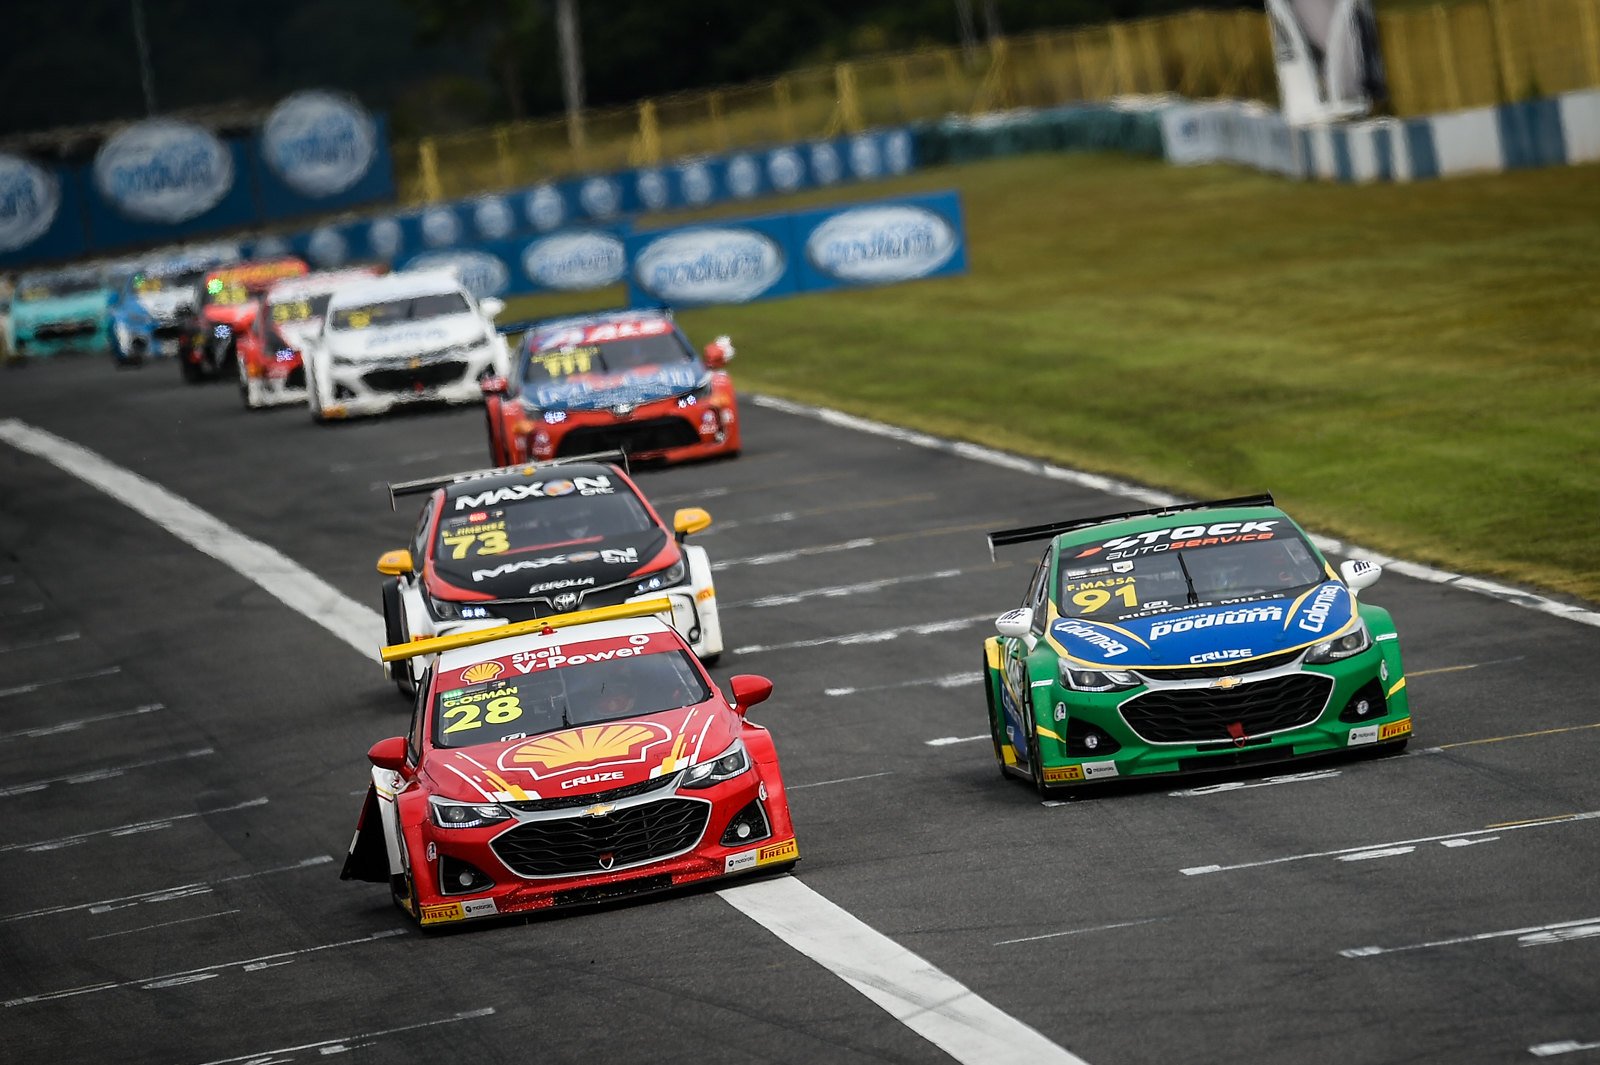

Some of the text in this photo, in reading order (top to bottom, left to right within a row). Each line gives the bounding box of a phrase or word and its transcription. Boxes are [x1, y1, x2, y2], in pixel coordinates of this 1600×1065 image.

[455, 475, 611, 510] MAXON
[443, 530, 510, 560] 73
[1102, 520, 1279, 550] STOCK
[472, 547, 638, 583] MAXON
[529, 577, 595, 594] COROLLA
[1067, 576, 1136, 592] F.MASSA
[1072, 583, 1138, 614] 91
[1118, 601, 1213, 621] RICHARD
[1220, 593, 1285, 605] MILLE
[1299, 584, 1341, 633] Colormag
[1149, 606, 1283, 641] podium
[511, 645, 562, 664] Shell
[1054, 621, 1129, 658] Colormag
[513, 645, 645, 675] V-Power
[1189, 648, 1253, 665] CRUZE
[443, 686, 518, 708] G.OSMAN
[442, 696, 523, 734] 28
[561, 771, 625, 789] CRUZE
[760, 841, 794, 861] PIRELLI
[422, 905, 459, 920] PIRELLI
